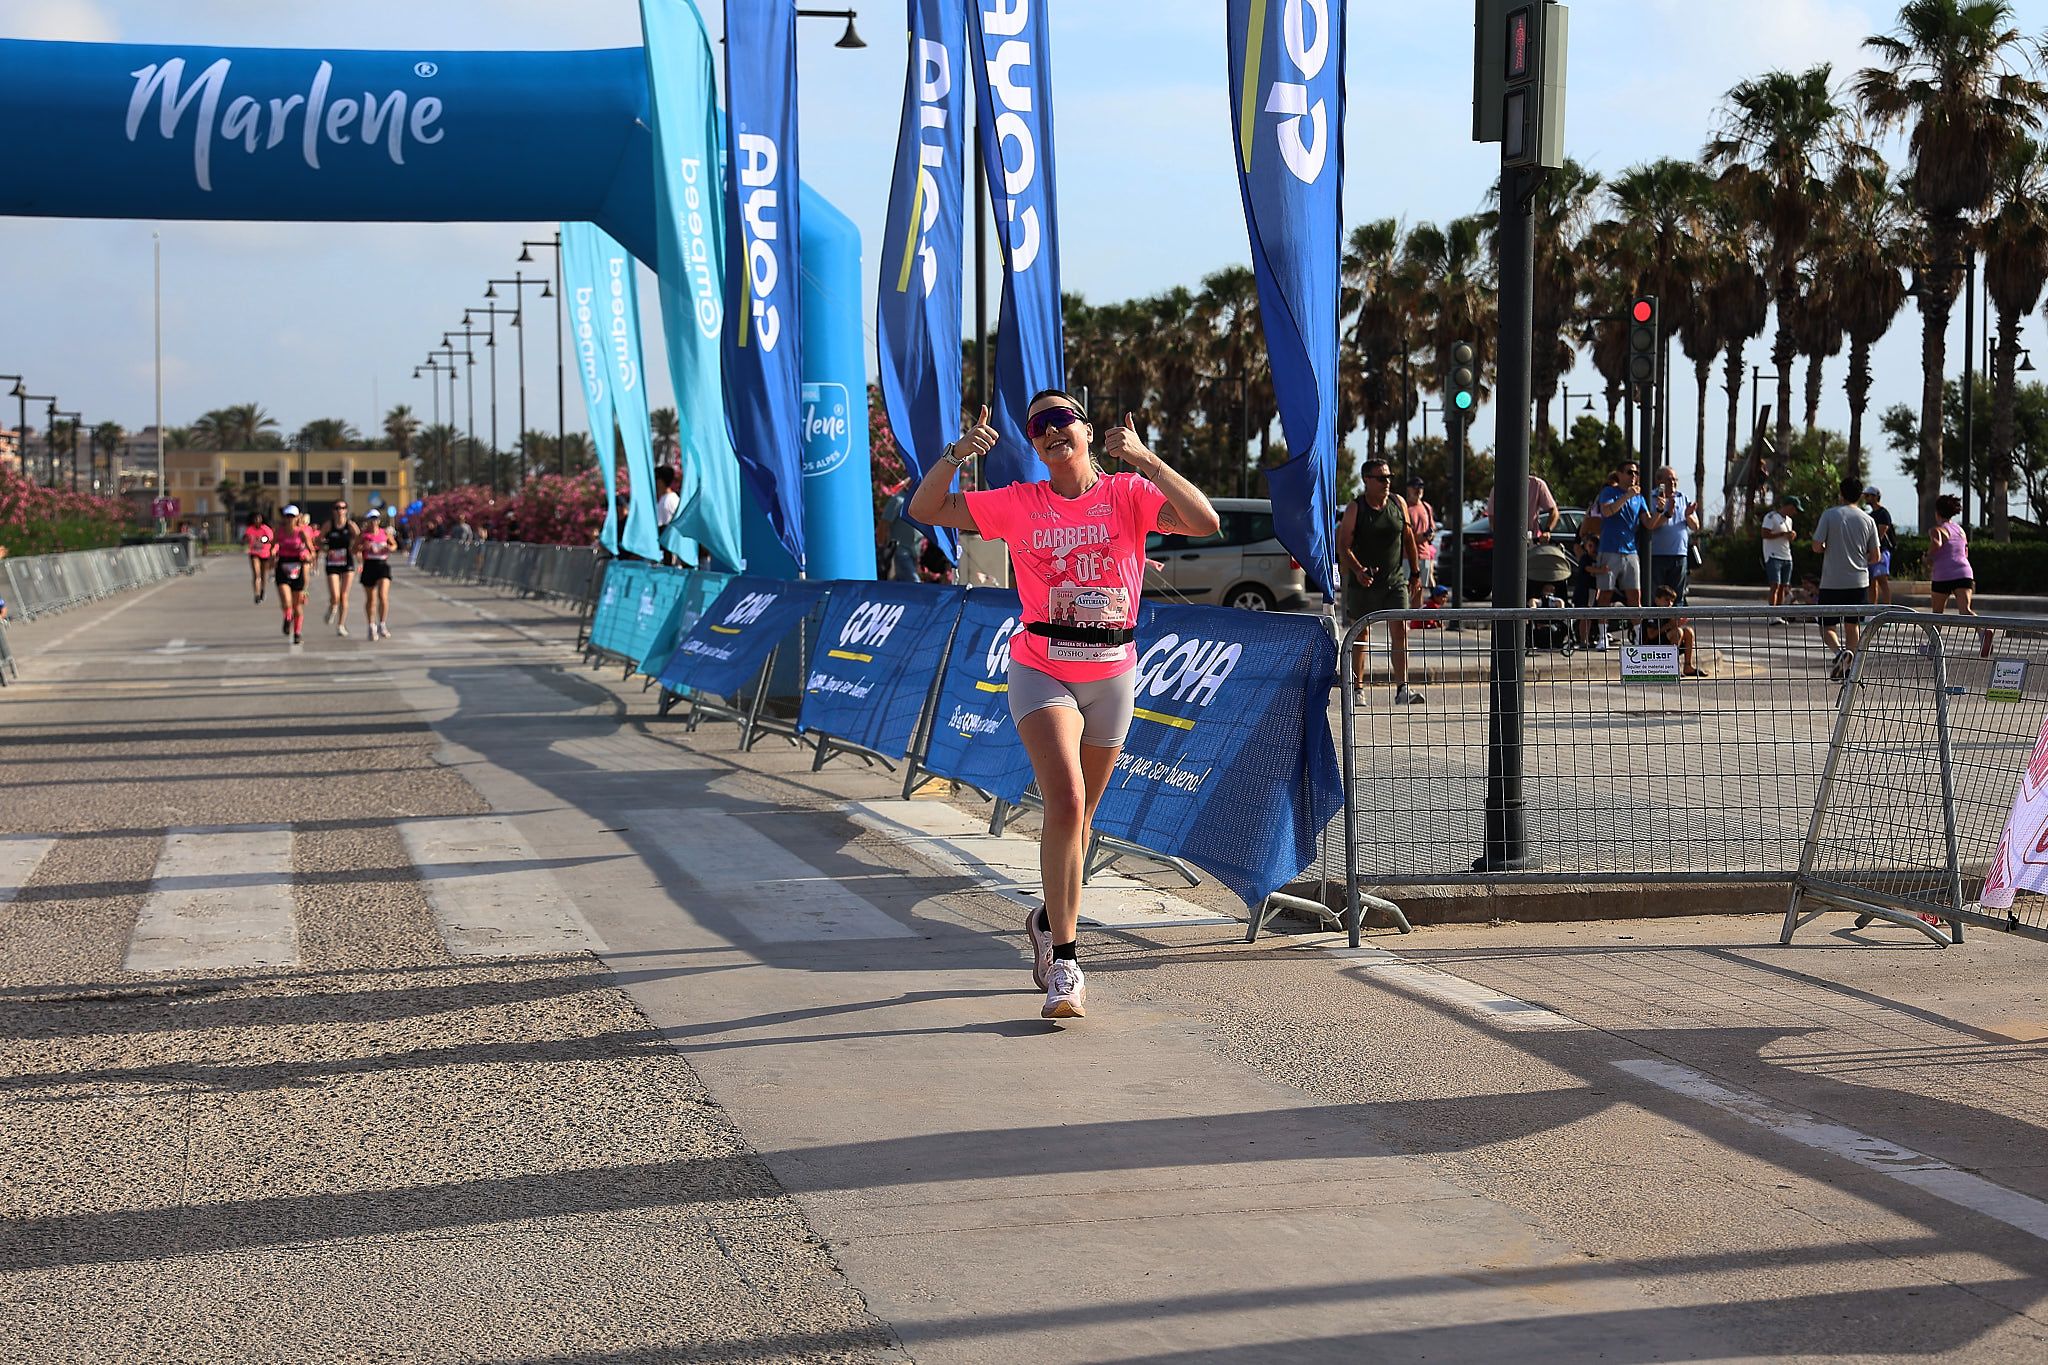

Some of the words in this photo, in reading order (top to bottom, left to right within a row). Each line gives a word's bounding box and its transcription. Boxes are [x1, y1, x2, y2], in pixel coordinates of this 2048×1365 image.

[126, 57, 444, 192] Marlene
[802, 404, 845, 443] lene
[1033, 523, 1111, 550] CARRERA
[1076, 551, 1102, 582] DE
[722, 592, 778, 625] GOYA
[839, 601, 905, 648] GOYA
[986, 616, 1026, 678] GO
[1057, 649, 1084, 657] OYSHO
[1134, 633, 1243, 707] GOYA
[1121, 756, 1152, 789] que
[1147, 761, 1169, 781] ser
[1164, 752, 1213, 792] bueno!
